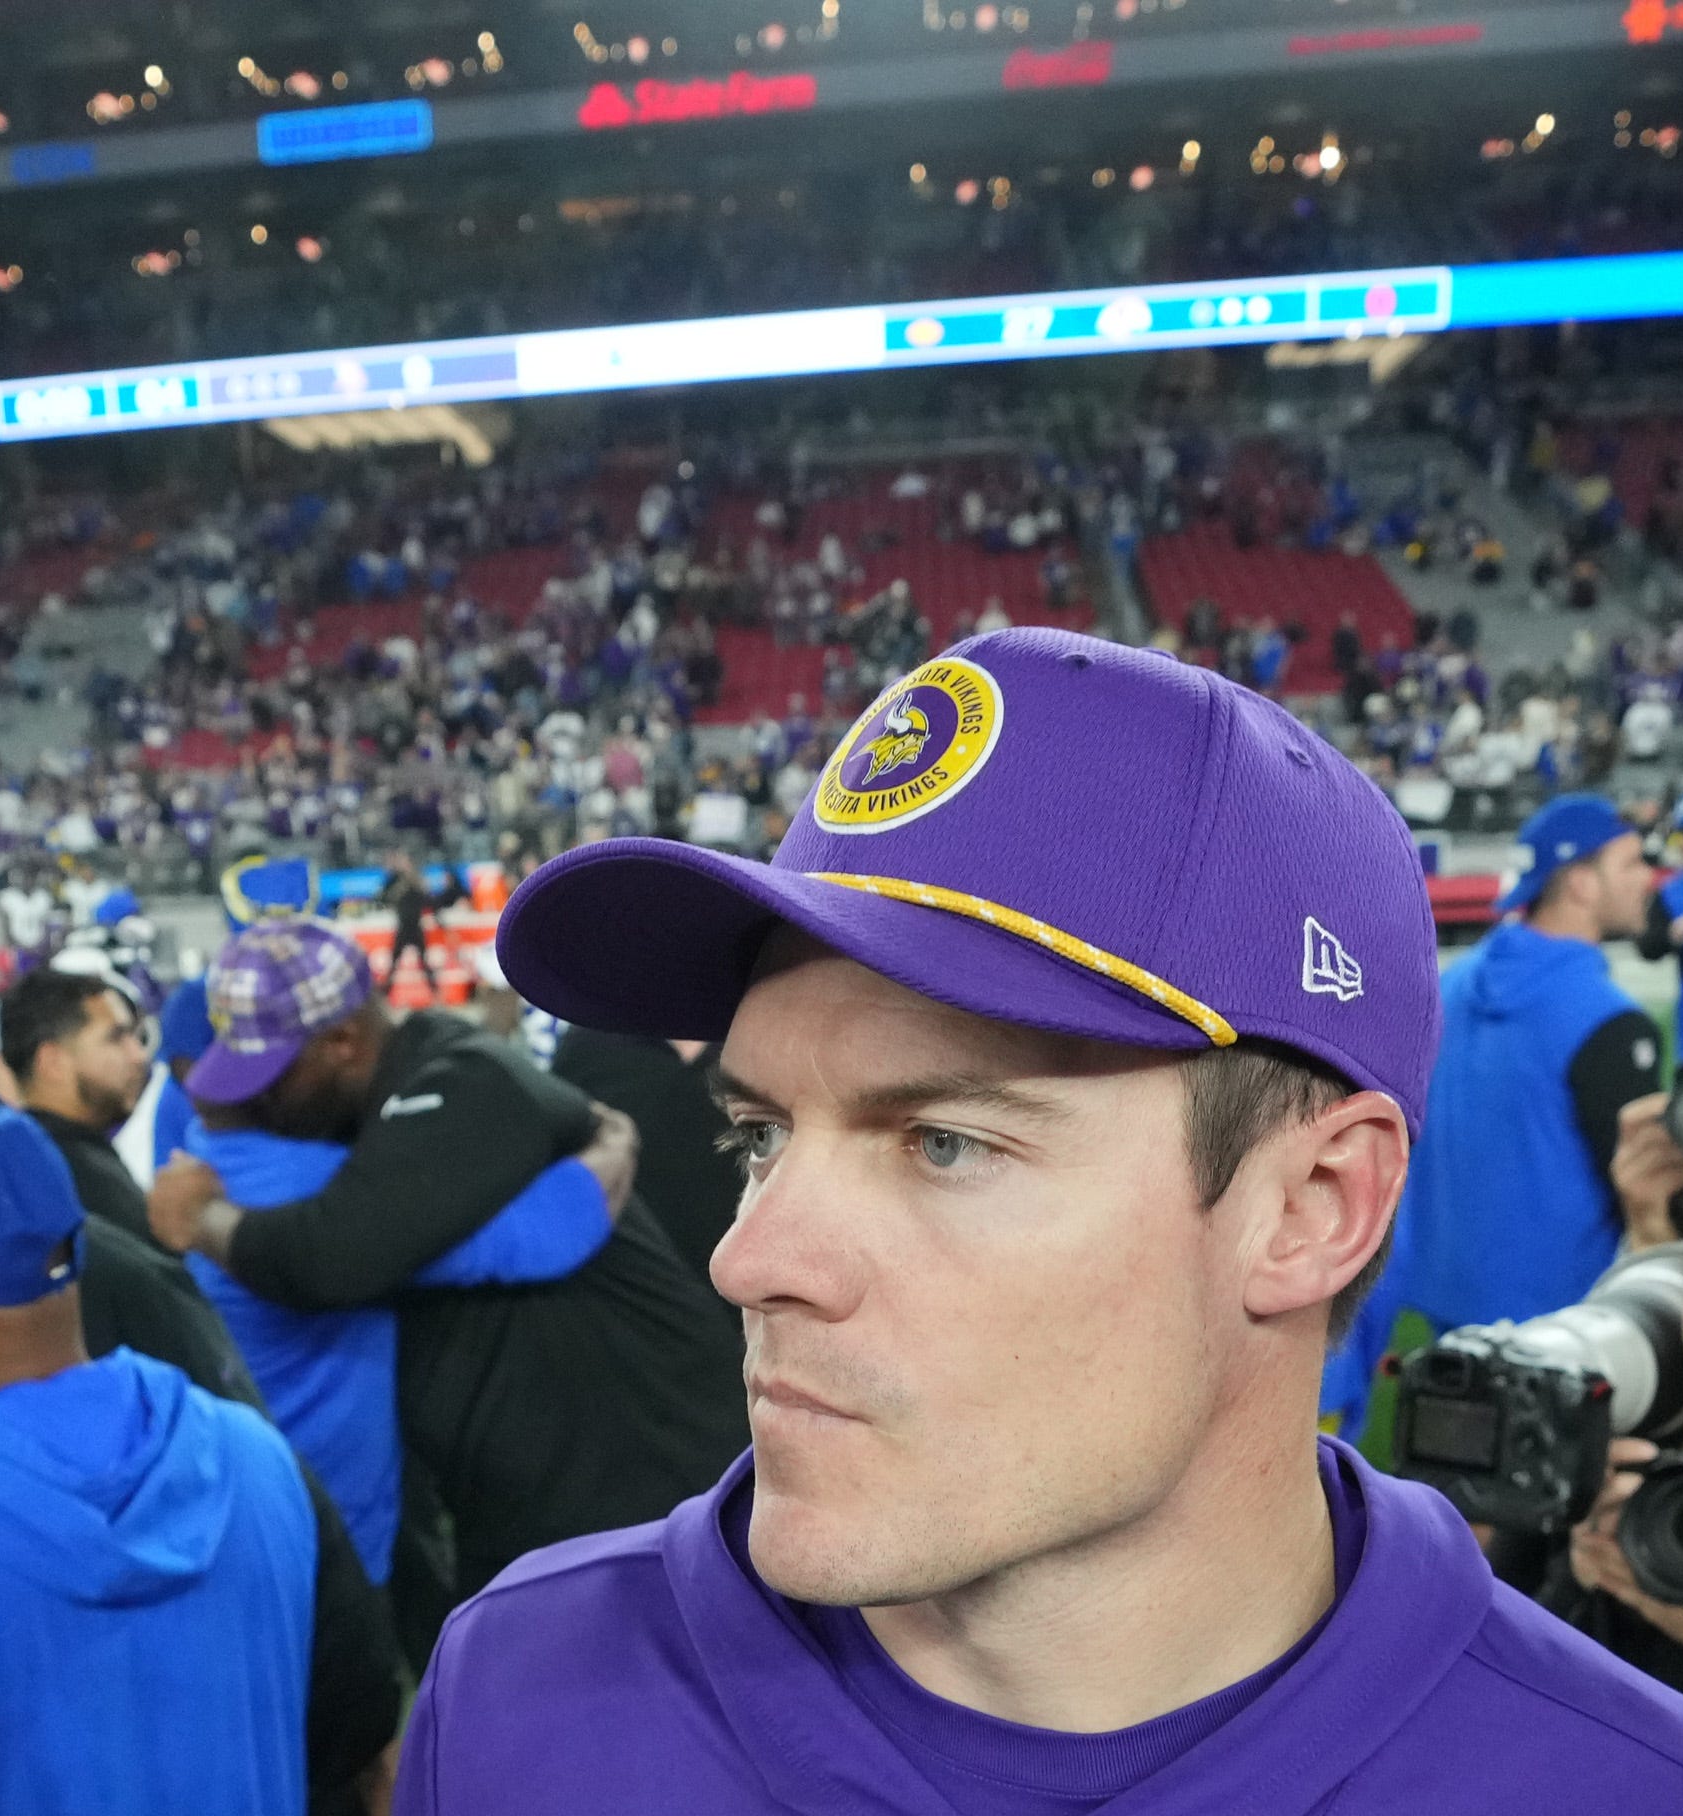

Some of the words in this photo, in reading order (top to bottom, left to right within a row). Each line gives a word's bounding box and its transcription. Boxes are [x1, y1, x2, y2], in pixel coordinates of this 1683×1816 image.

[949, 674, 984, 735] VIKINGS
[823, 760, 861, 815] MINNESOTA
[867, 765, 949, 813] VIKINGS
